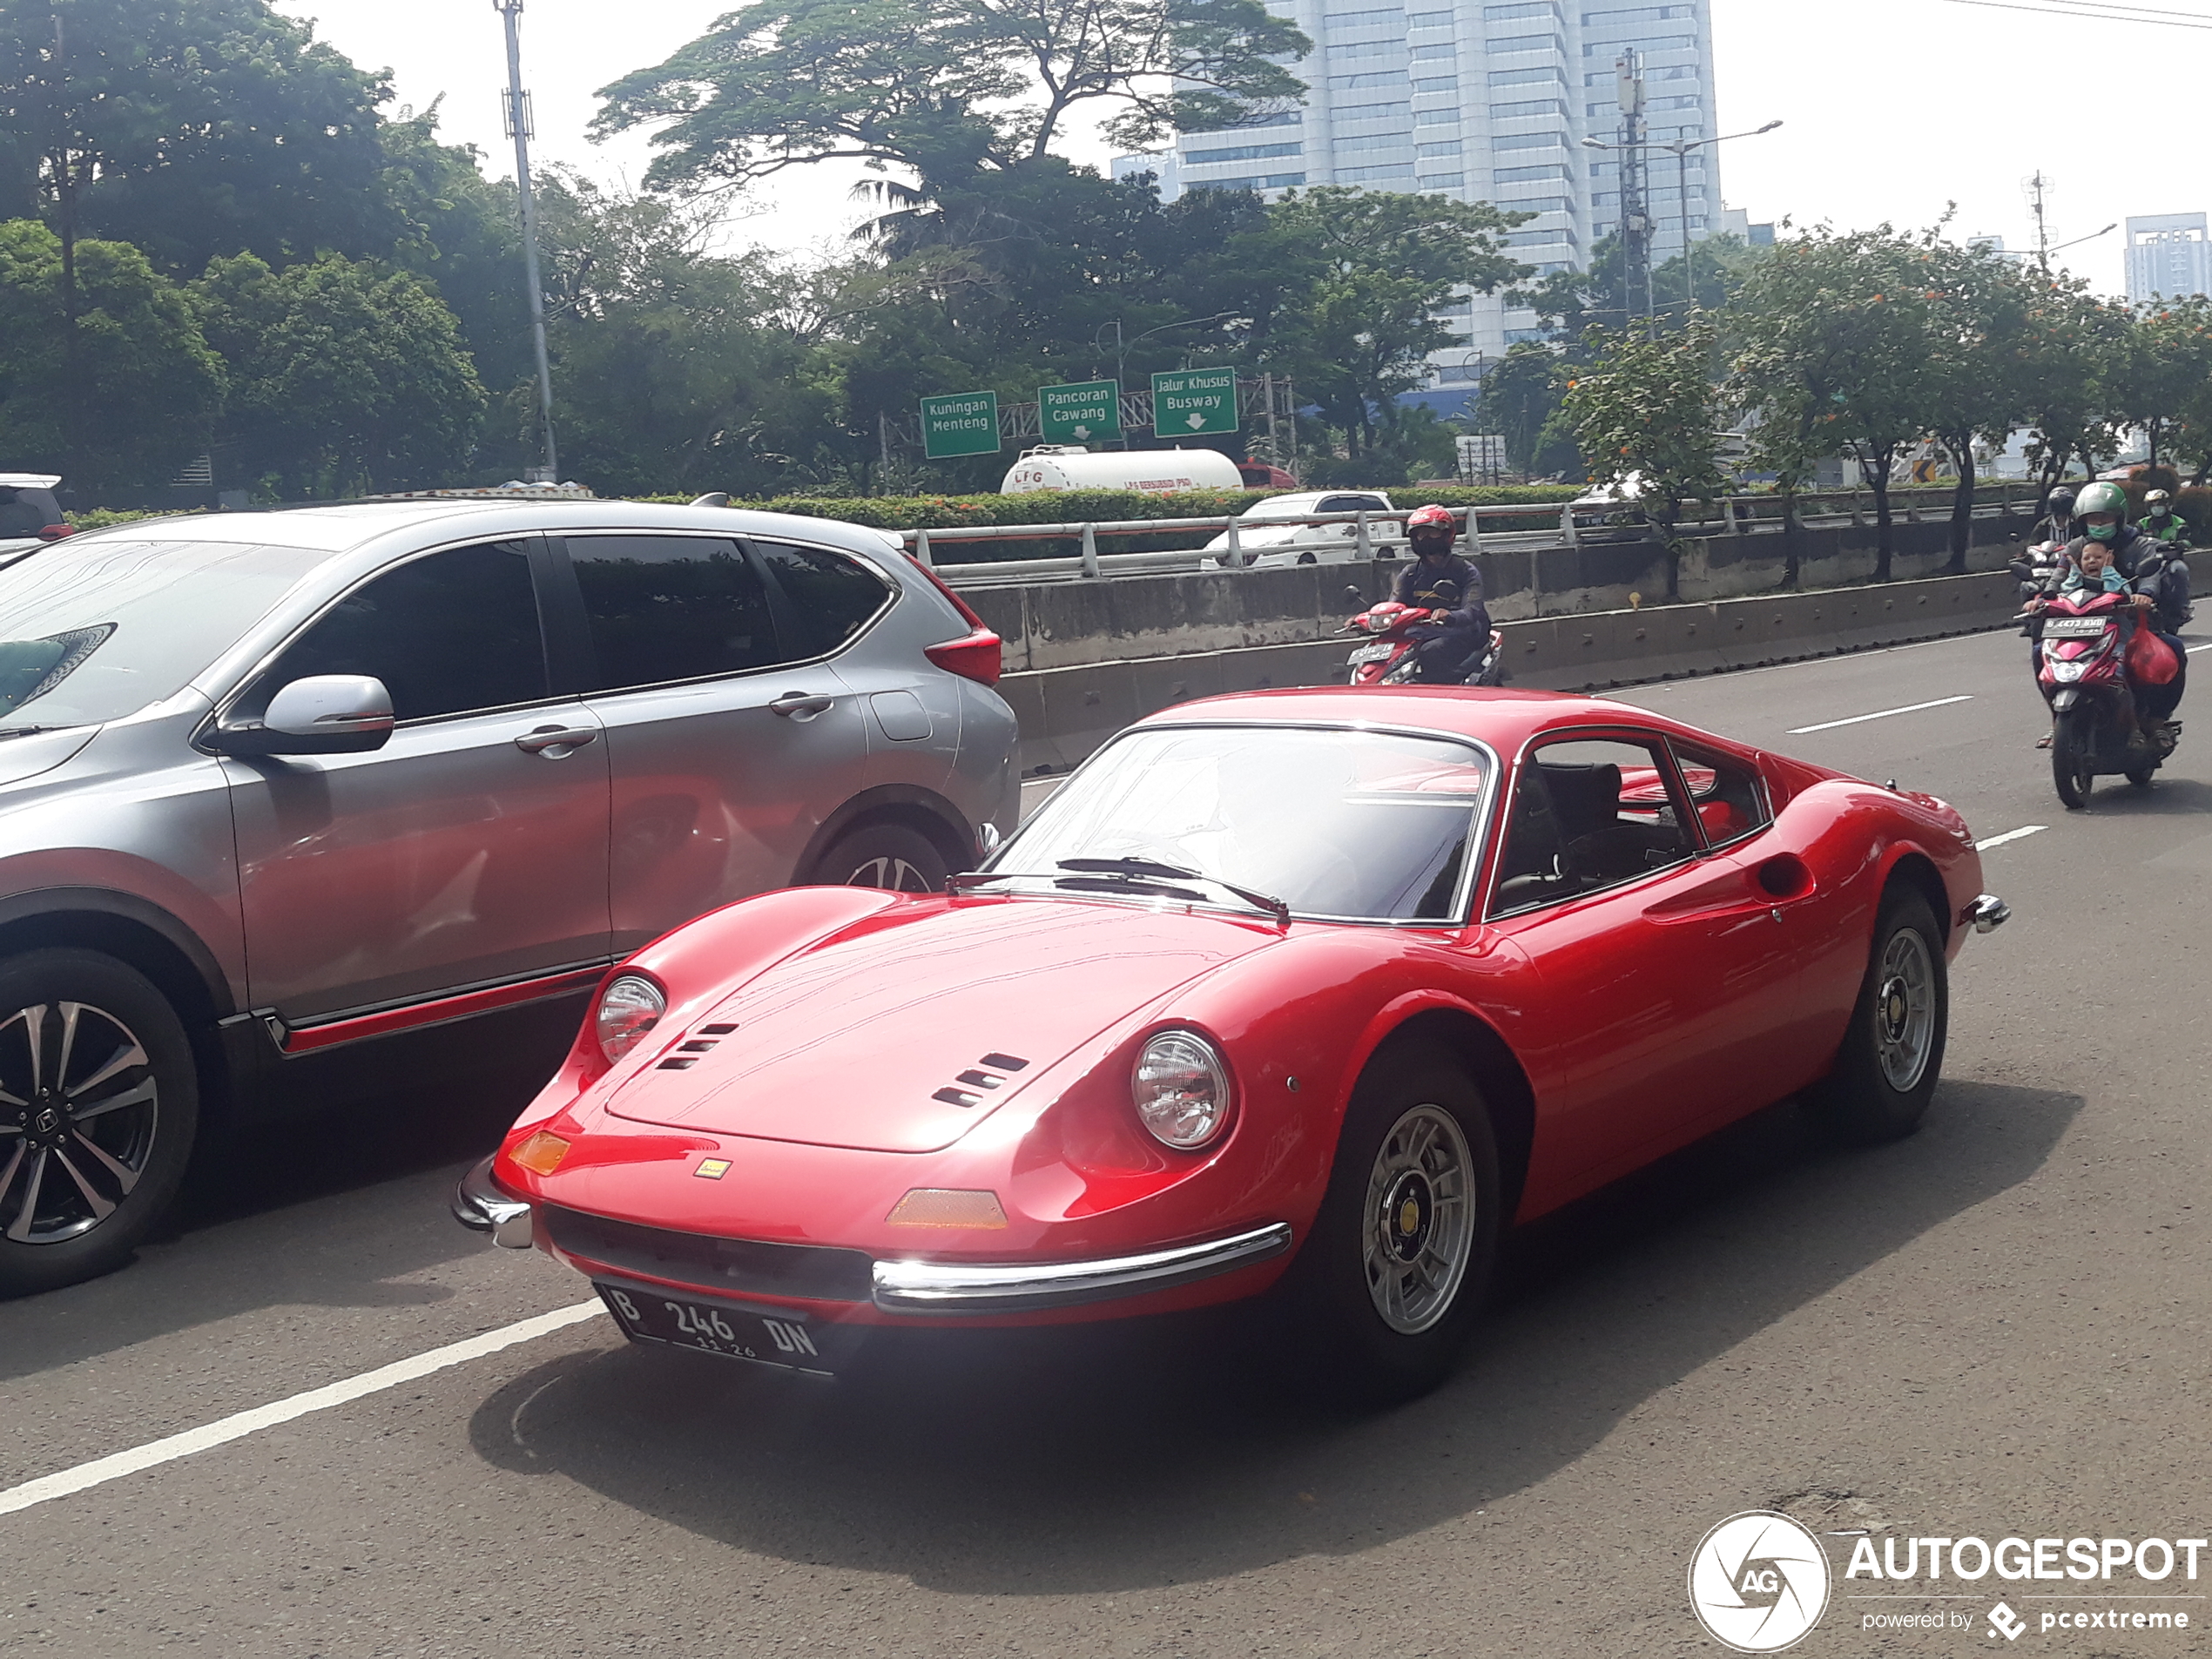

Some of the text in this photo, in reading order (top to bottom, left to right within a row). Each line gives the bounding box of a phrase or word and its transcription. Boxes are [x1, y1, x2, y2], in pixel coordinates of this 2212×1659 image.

[1157, 375, 1230, 393] Jalur Khusus
[1048, 390, 1109, 405] Pancoran
[1166, 395, 1222, 410] Busway
[929, 401, 988, 415] Kuningan
[1052, 407, 1106, 423] Cawang
[933, 417, 988, 433] Menteng
[610, 1289, 819, 1357] B 246 DN
